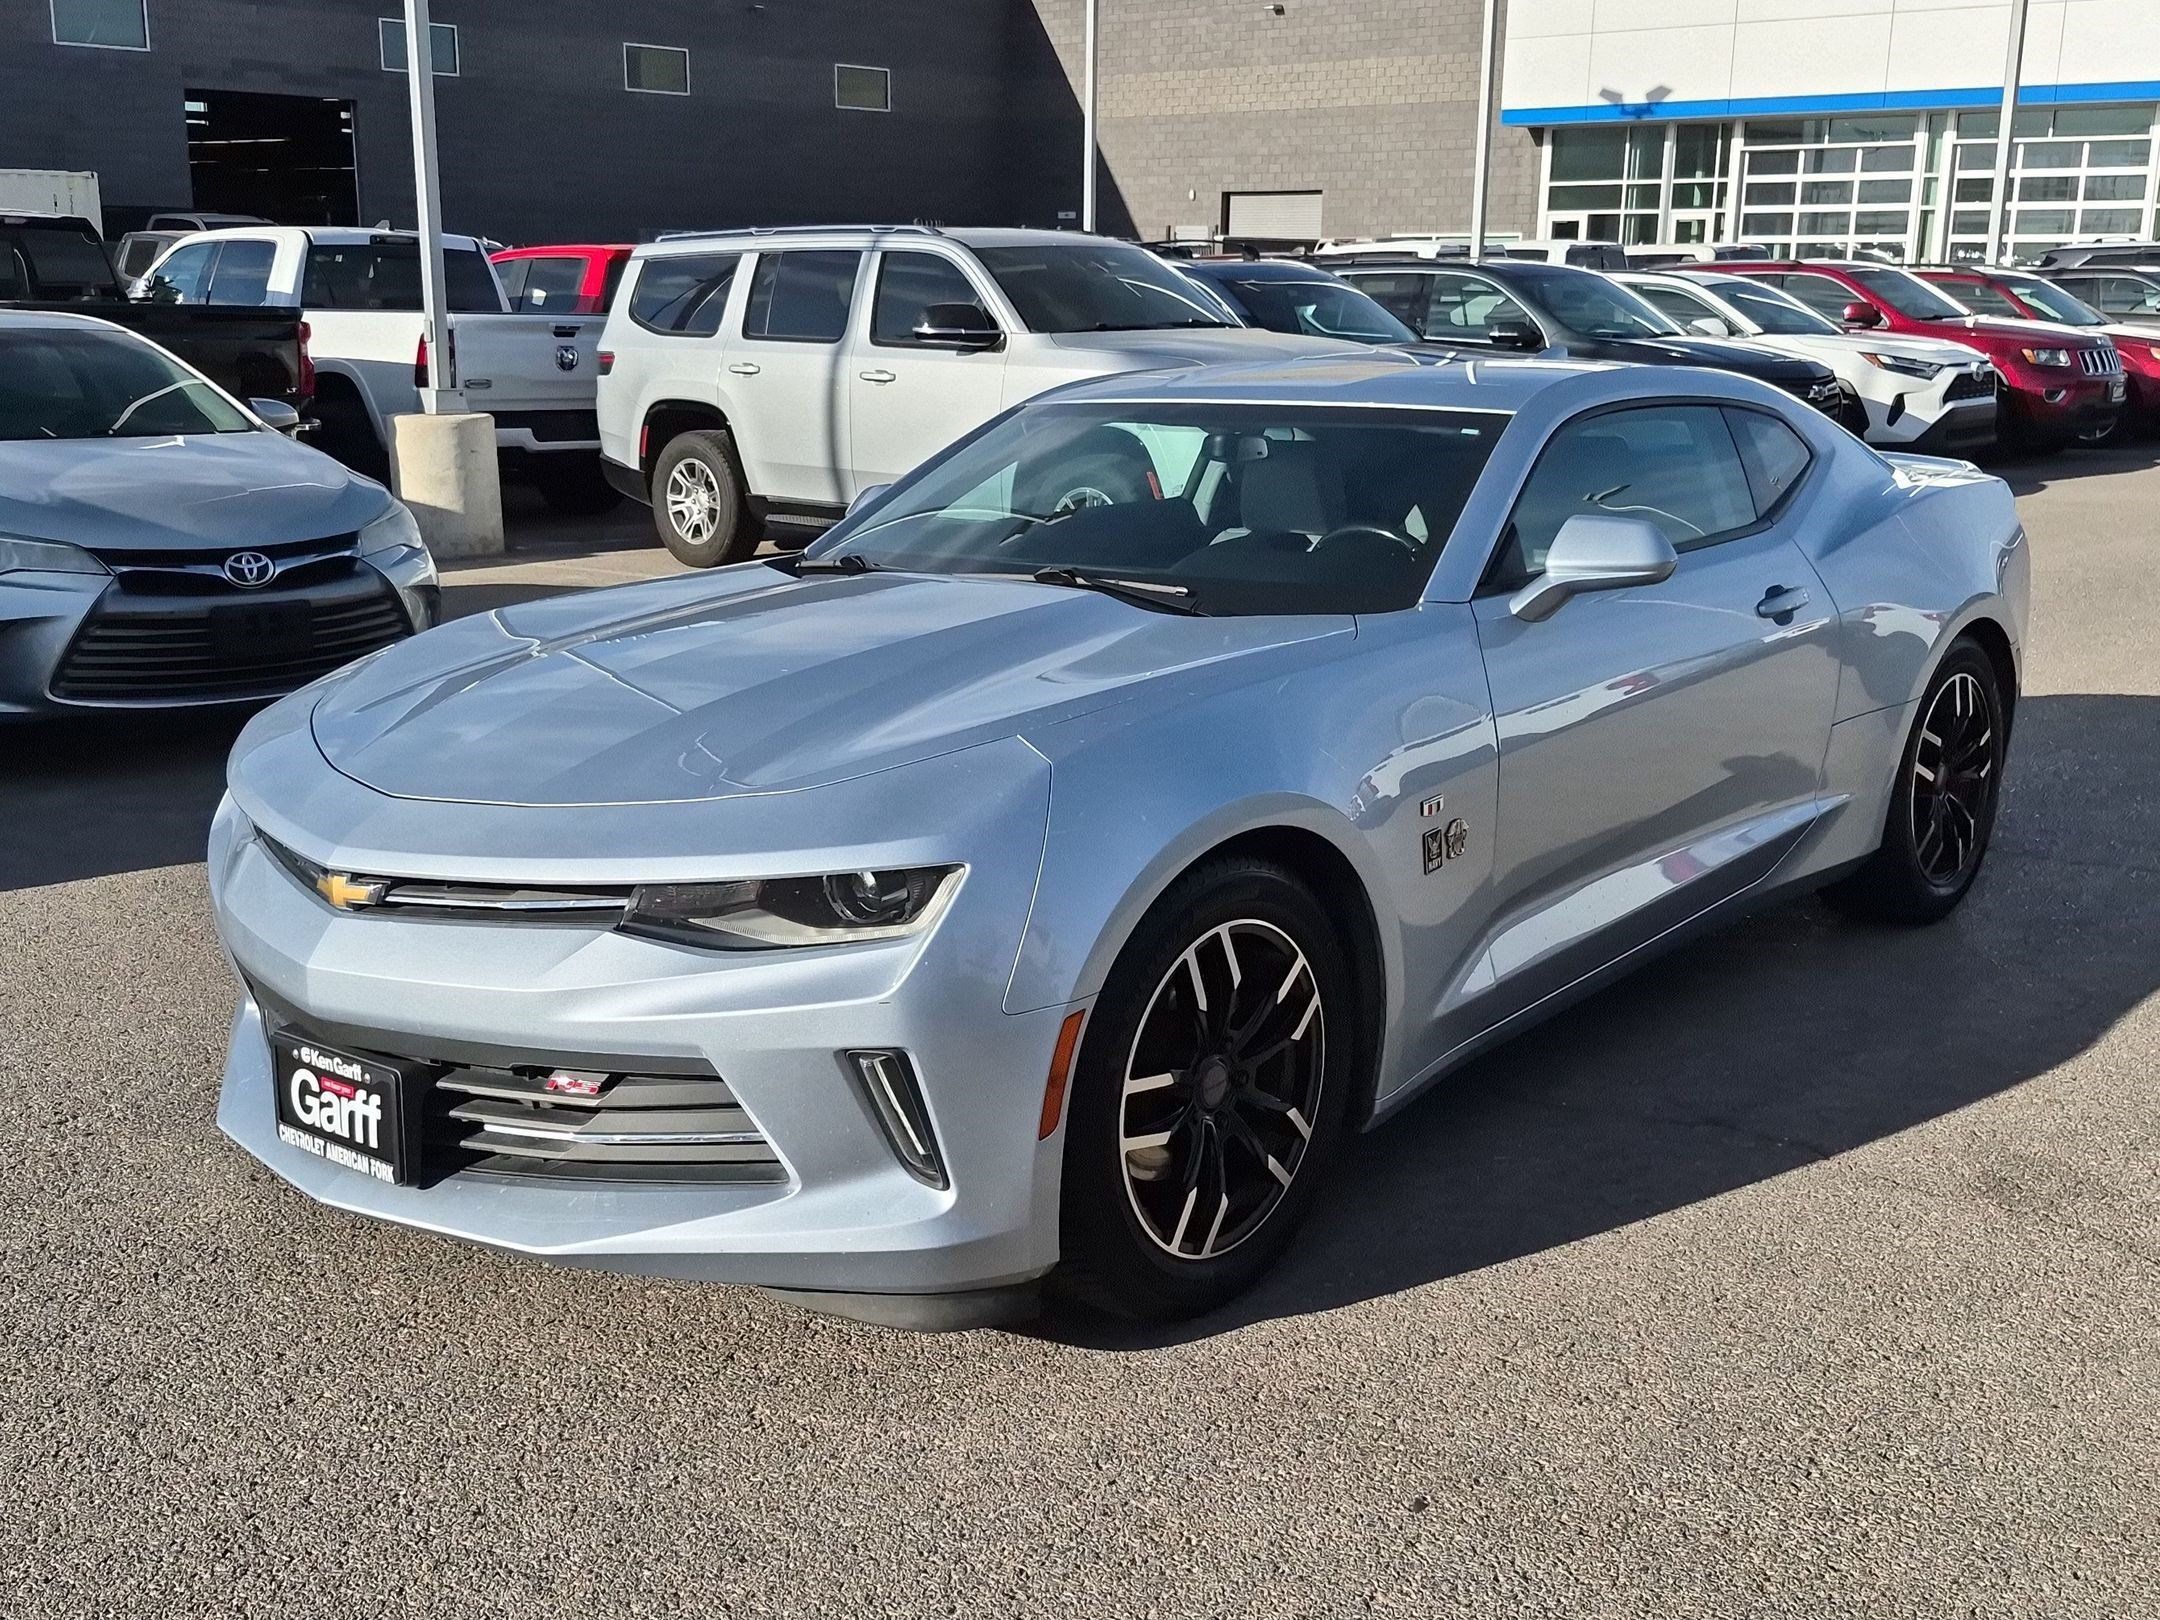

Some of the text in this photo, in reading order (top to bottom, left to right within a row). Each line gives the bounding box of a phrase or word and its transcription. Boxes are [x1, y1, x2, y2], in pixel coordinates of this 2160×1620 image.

[310, 1048, 362, 1082] Ken Garff
[291, 1068, 381, 1149] Garff
[279, 1124, 395, 1185] CHEVROLET AMERICAN FORK
